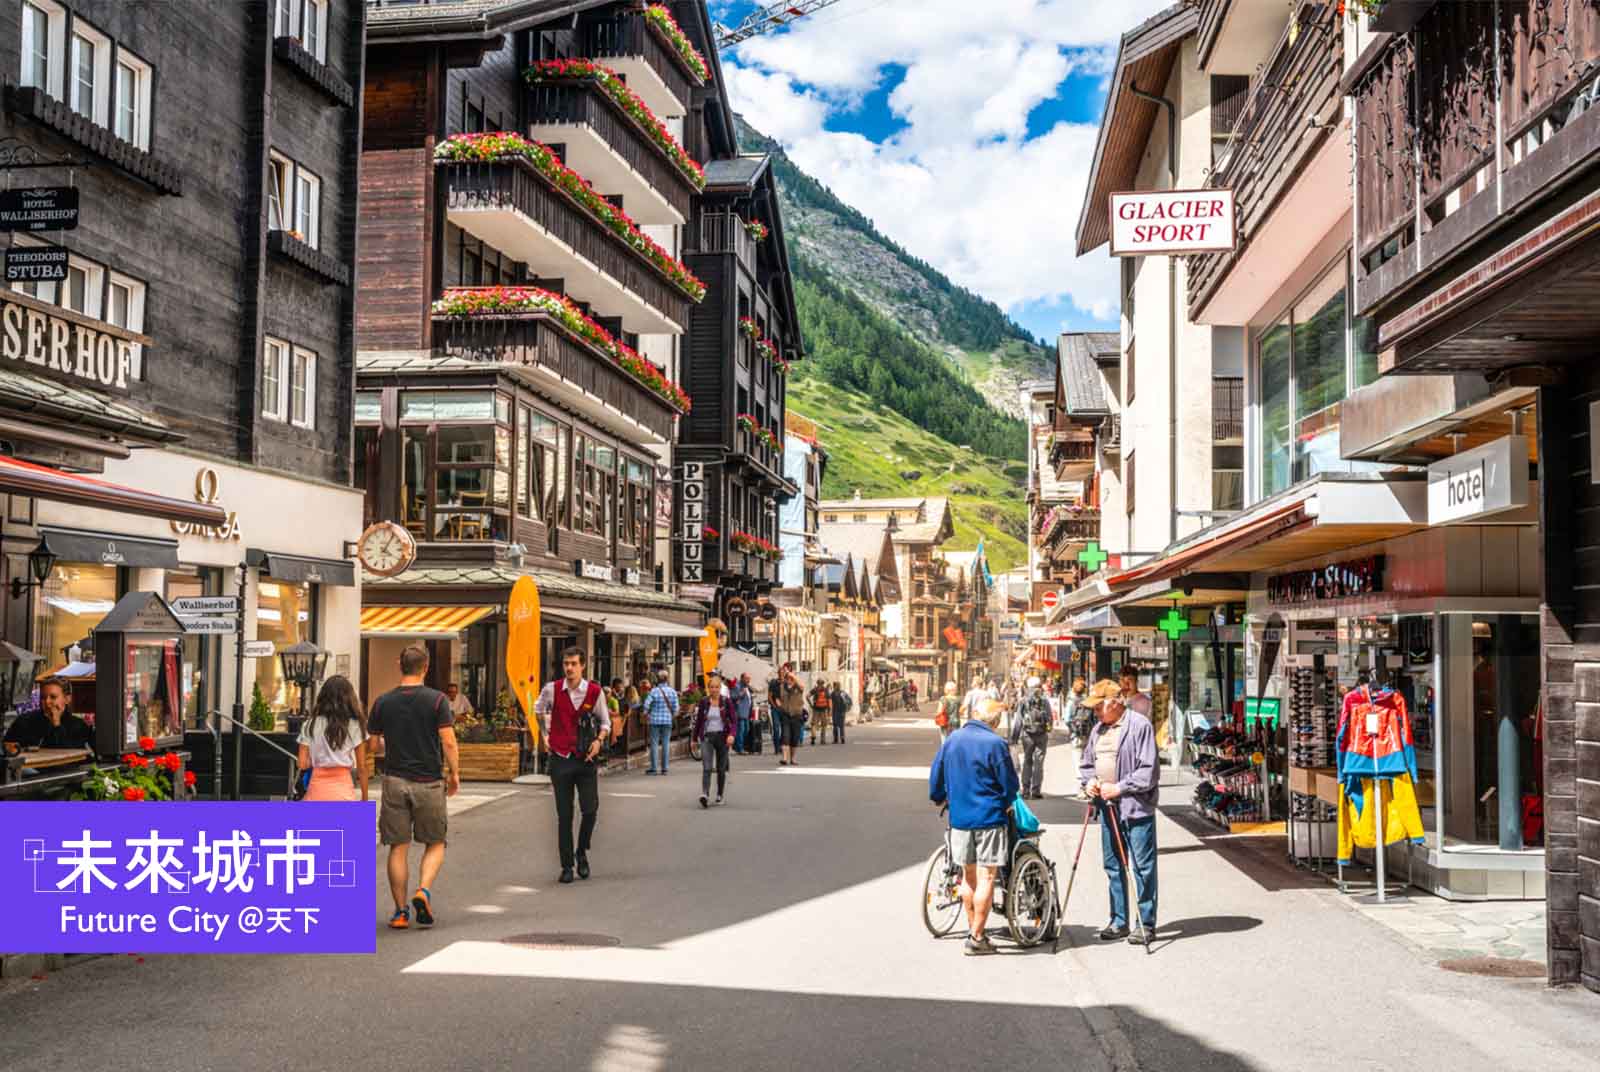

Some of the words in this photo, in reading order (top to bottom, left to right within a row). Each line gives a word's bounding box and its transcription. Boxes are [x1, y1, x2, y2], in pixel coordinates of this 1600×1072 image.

[23, 199, 56, 209] HOTEL
[1119, 200, 1224, 220] GLACIER
[0, 208, 78, 221] WALLISERHOF
[1132, 223, 1211, 243] SPORT
[7, 252, 67, 262] THEODORS
[7, 265, 65, 278] STUBA
[2, 303, 133, 388] SERHOF
[1447, 458, 1486, 507] hotel
[684, 462, 702, 581] POLLUX
[179, 600, 235, 609] Walliserhof
